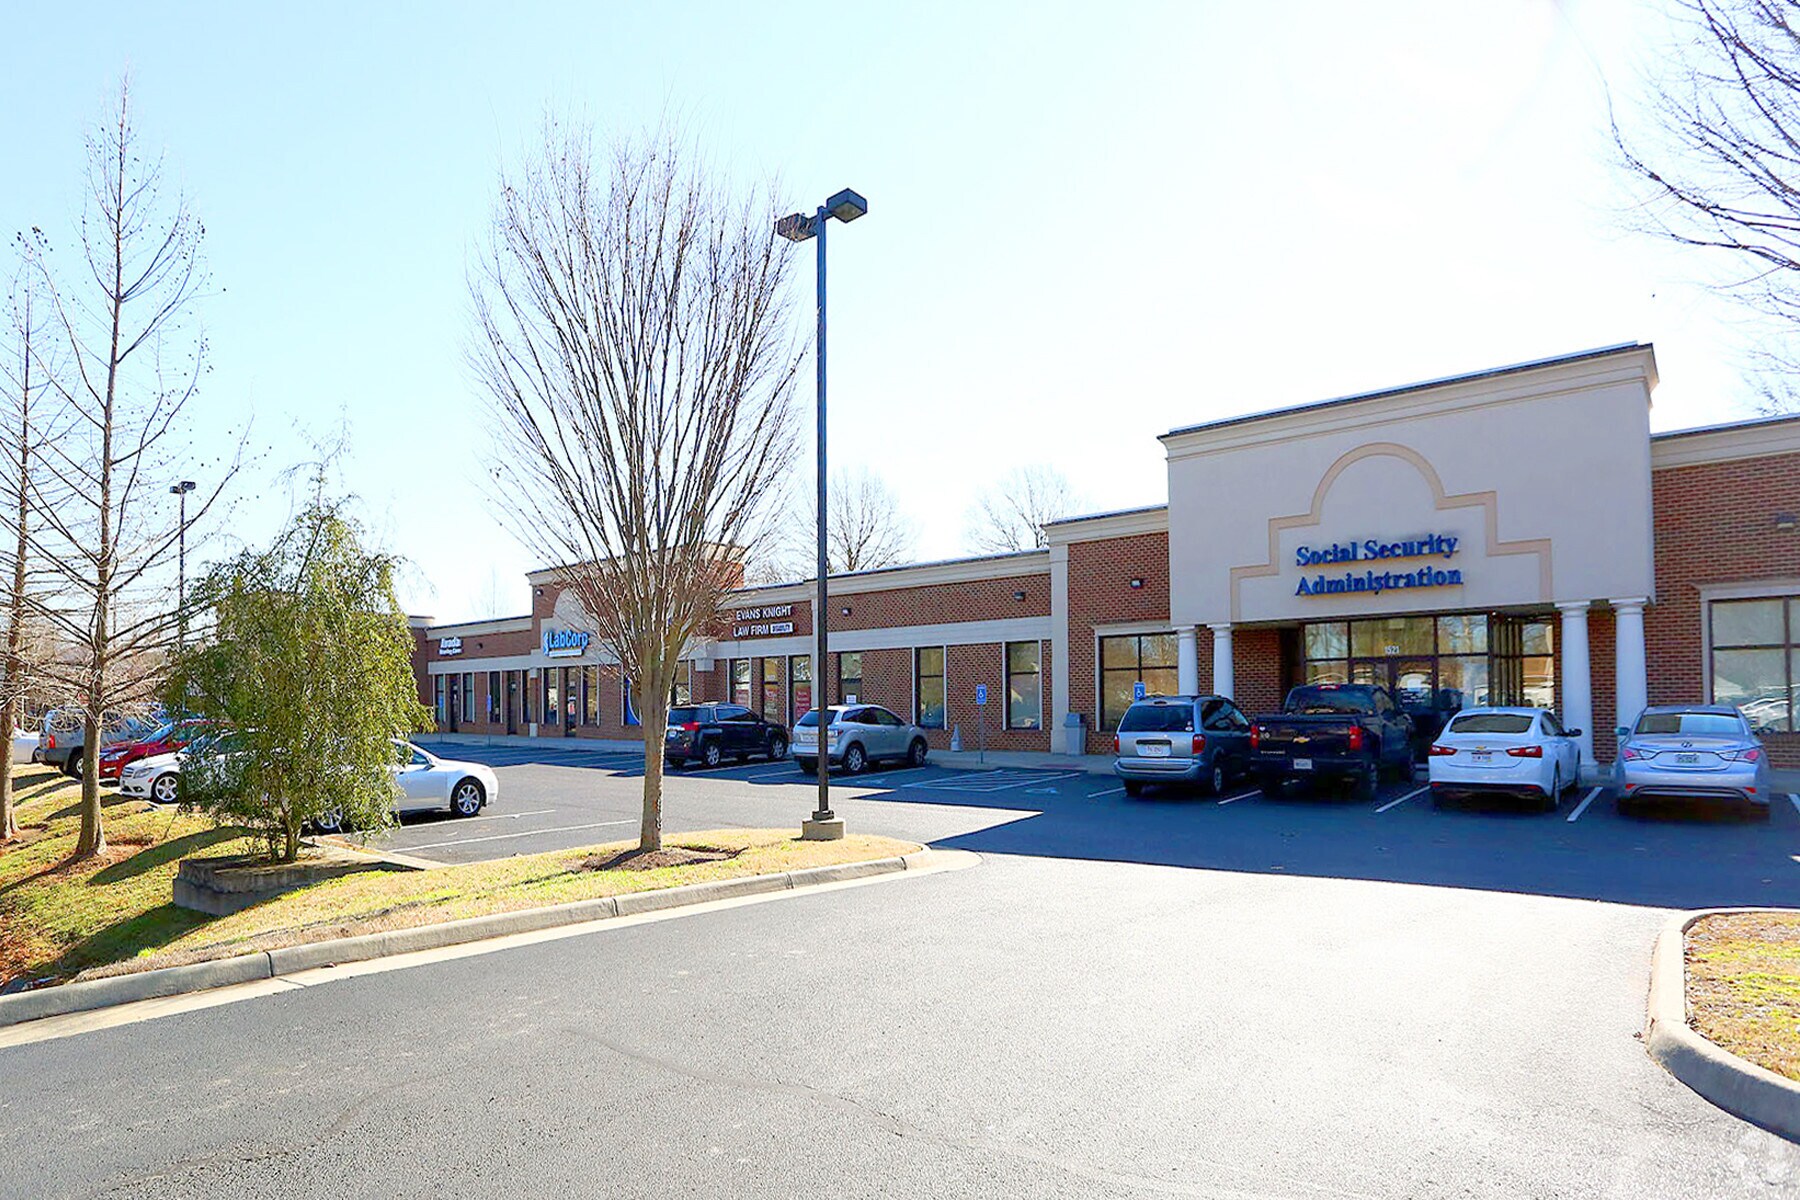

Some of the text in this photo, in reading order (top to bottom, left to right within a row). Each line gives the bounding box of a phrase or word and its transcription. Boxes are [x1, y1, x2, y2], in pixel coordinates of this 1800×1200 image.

[1296, 533, 1459, 567] Social Security
[1295, 565, 1464, 596] Administration
[736, 605, 792, 621] EVANS KNIGHT
[549, 629, 589, 650] LabCorp
[733, 625, 750, 638] LAW
[751, 623, 769, 636] FIRM
